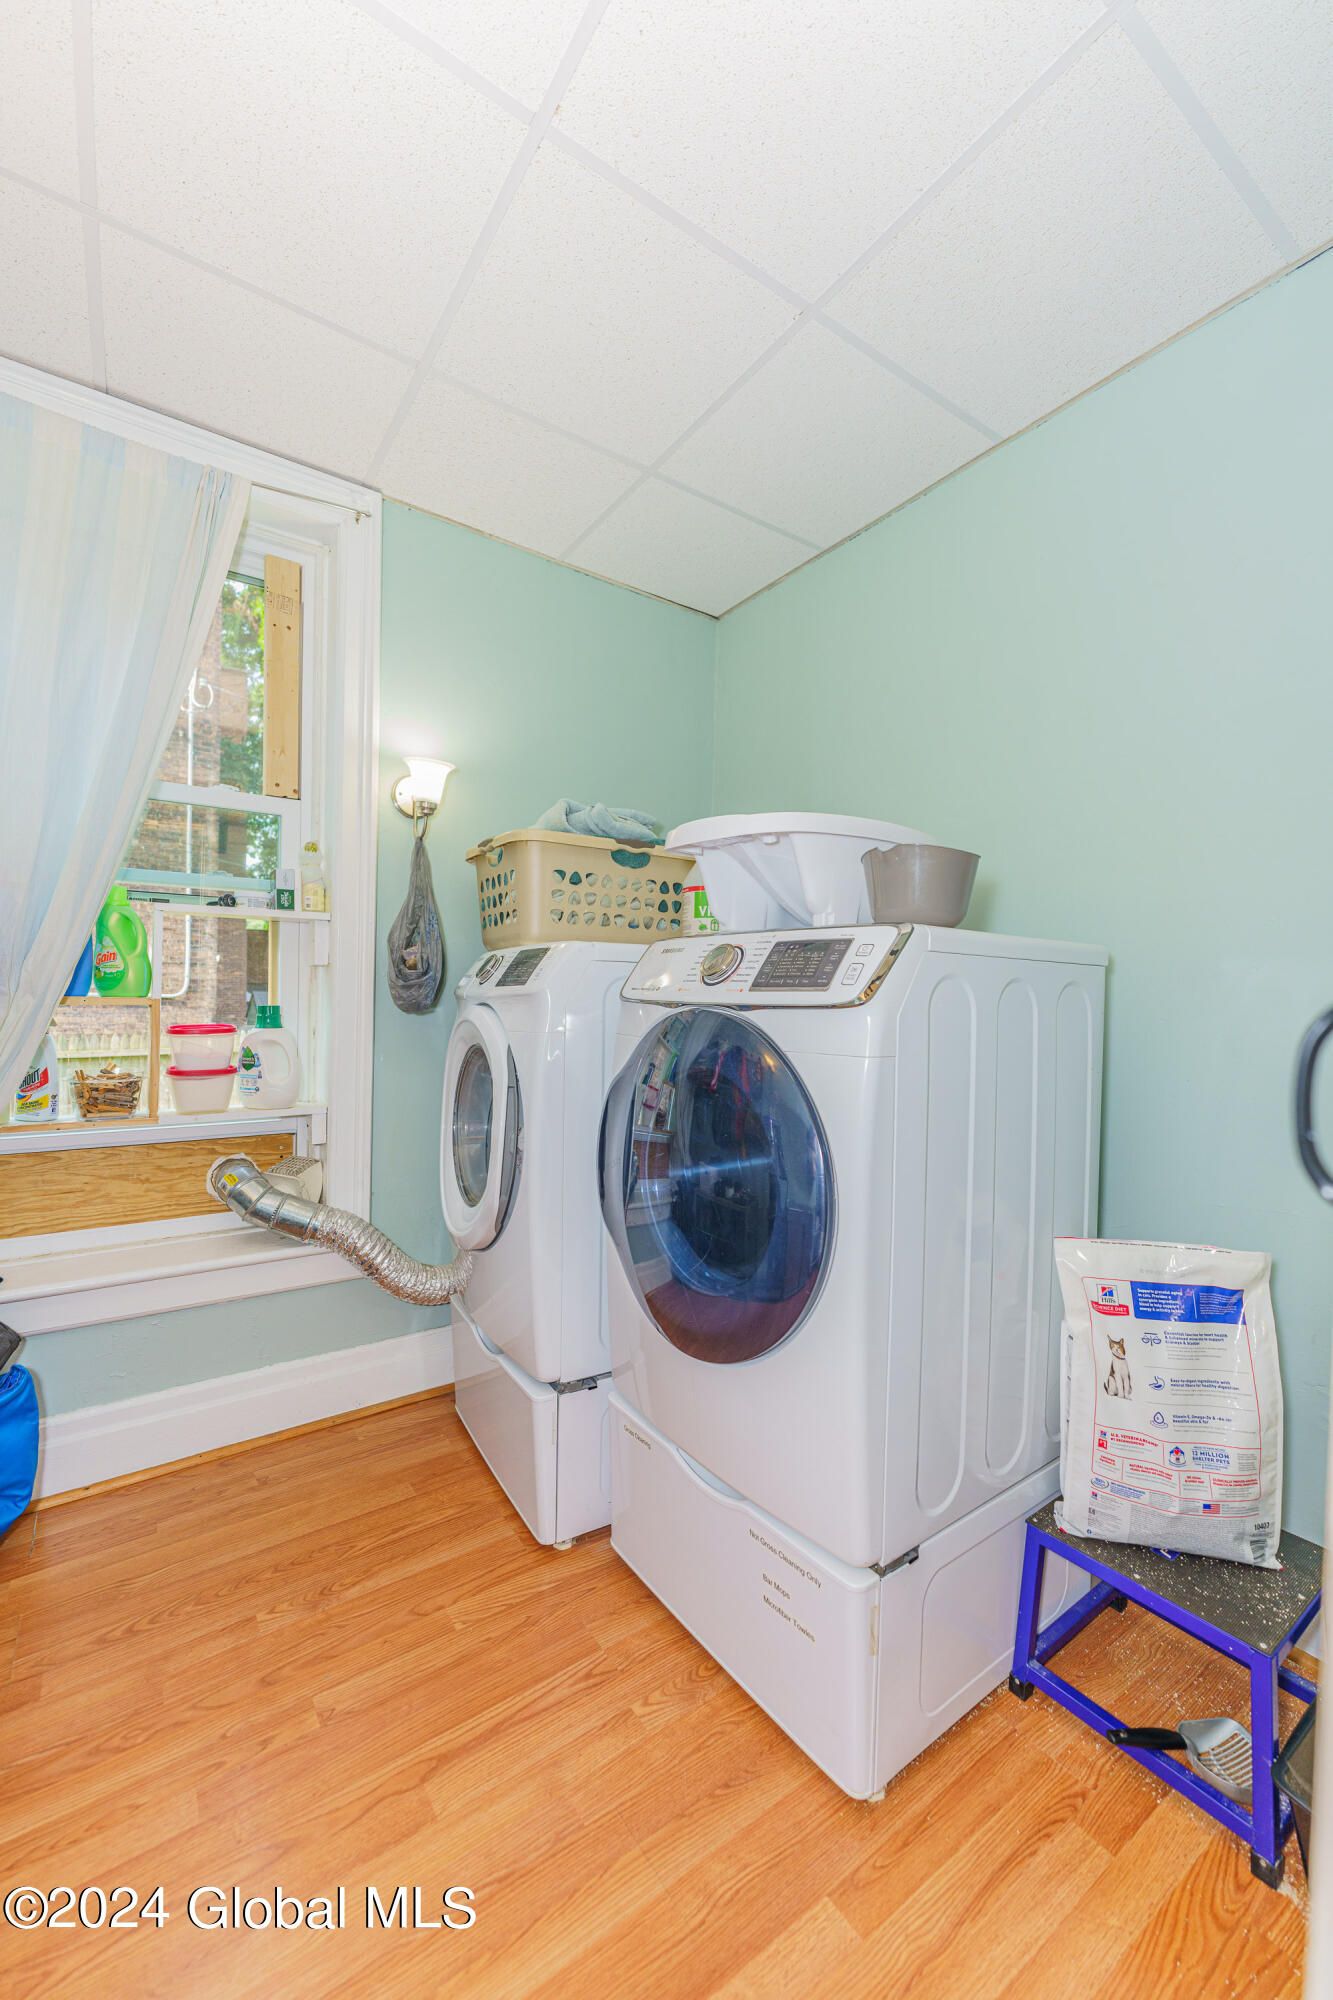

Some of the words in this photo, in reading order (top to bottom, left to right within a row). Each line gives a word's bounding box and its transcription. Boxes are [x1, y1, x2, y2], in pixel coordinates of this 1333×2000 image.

[96, 951, 116, 966] Gain
[1200, 1451, 1230, 1459] MILLION
[760, 1537, 778, 1555] Gross
[778, 1550, 806, 1577] Cleaning
[806, 1571, 822, 1589] Only
[774, 1581, 791, 1600] Mops
